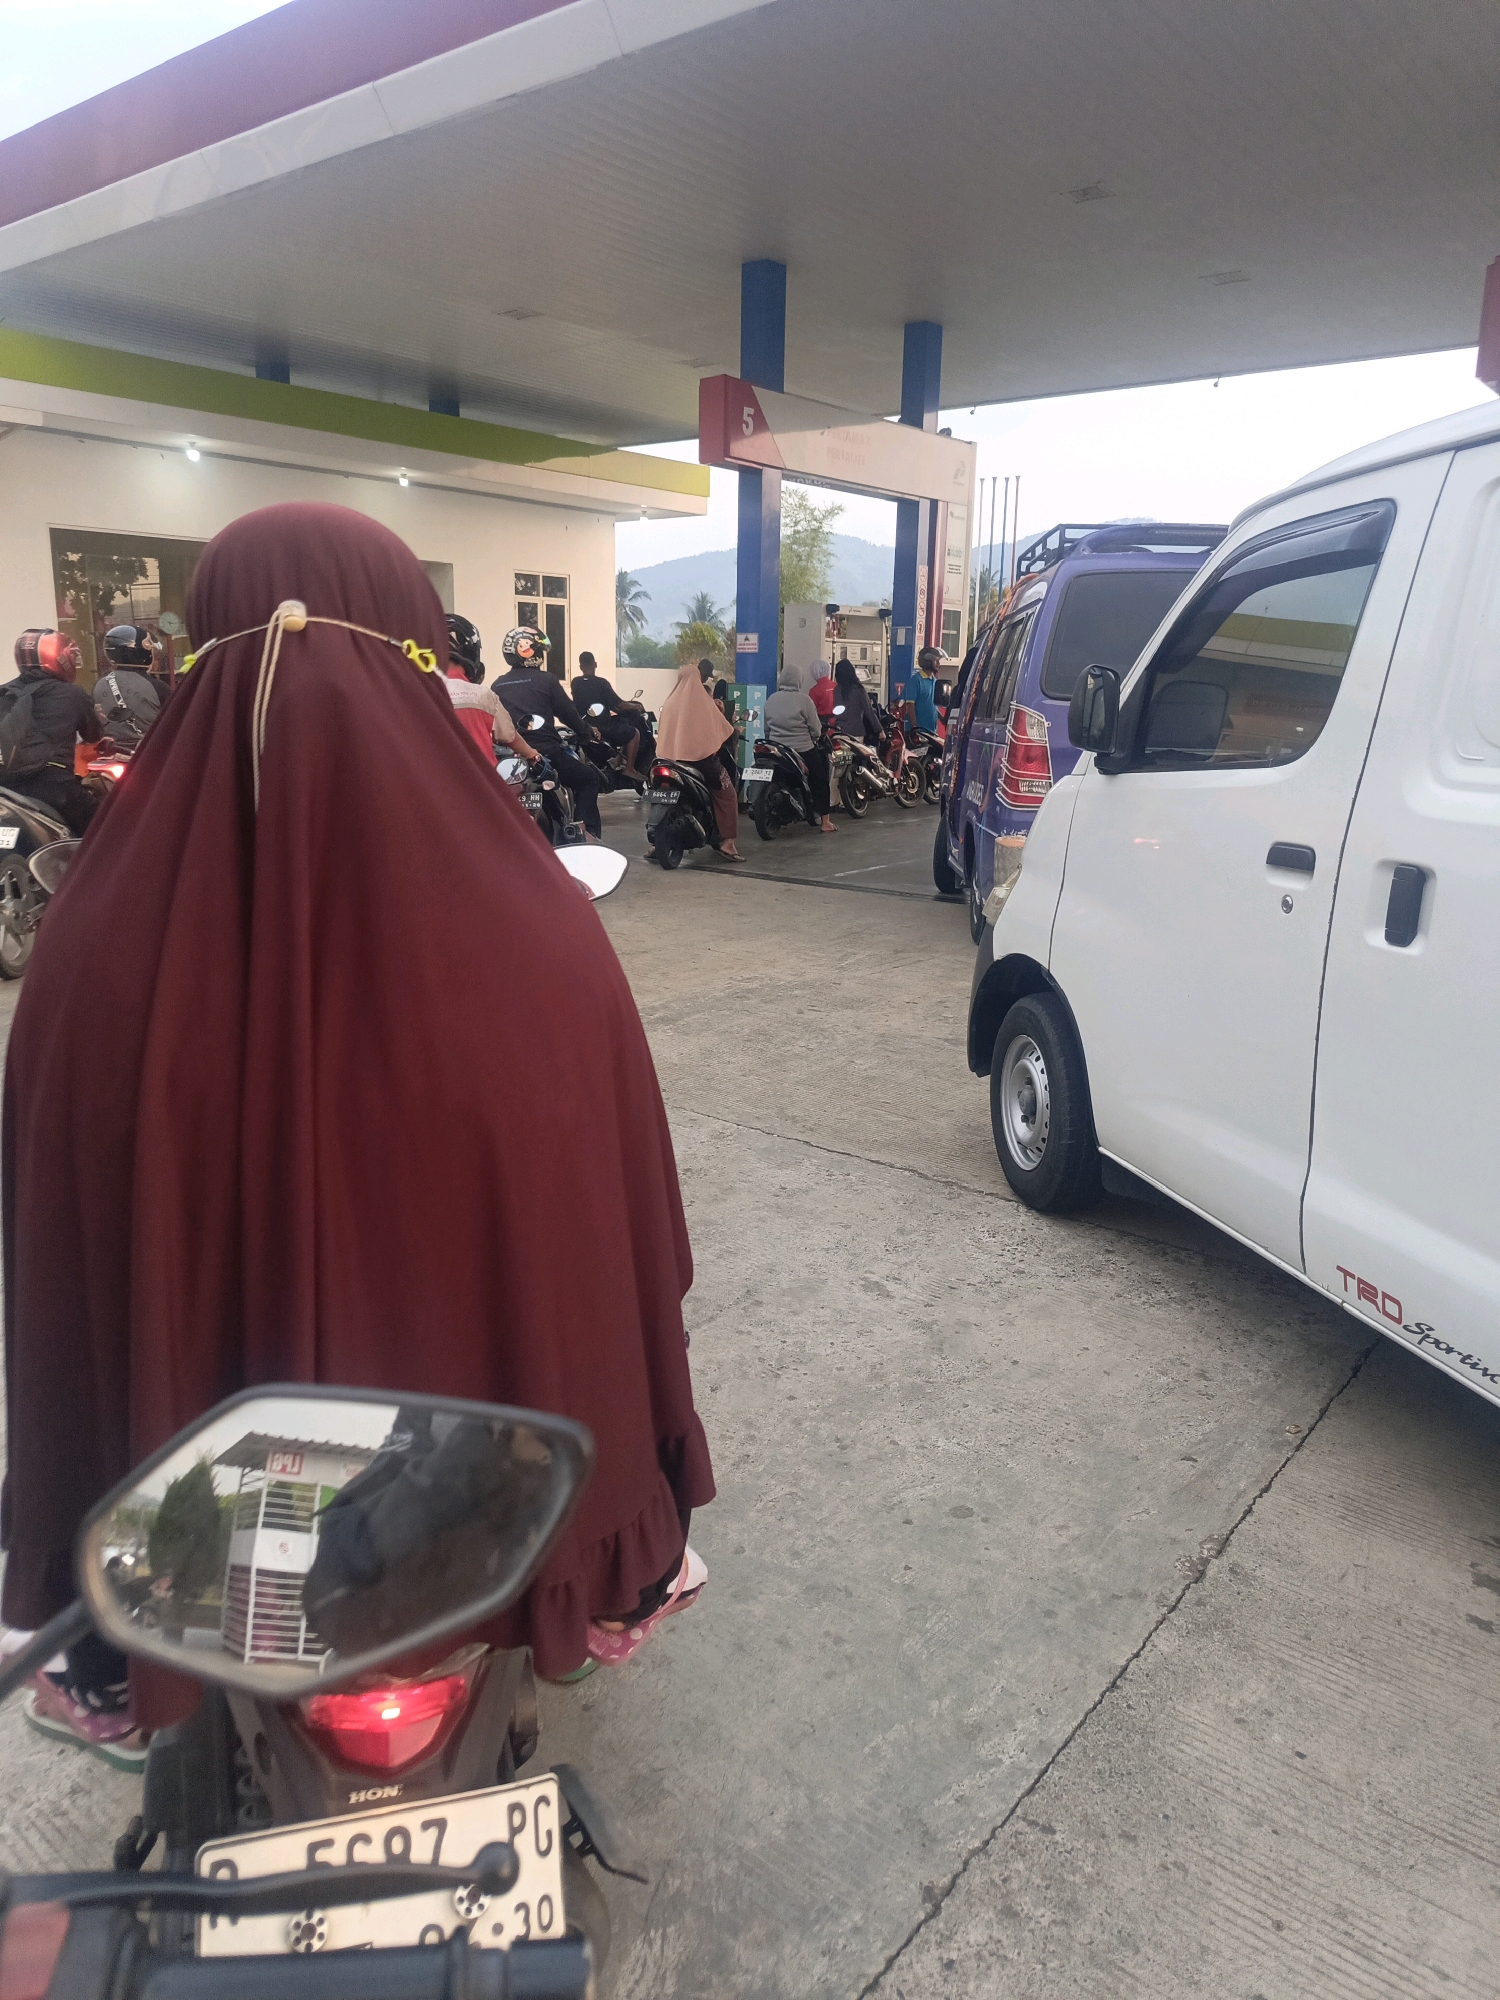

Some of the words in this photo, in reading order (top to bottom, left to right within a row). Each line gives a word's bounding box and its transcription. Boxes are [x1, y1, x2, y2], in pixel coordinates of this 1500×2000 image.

[742, 406, 755, 436] 5
[1336, 1264, 1403, 1326] TRD
[348, 1784, 404, 1804] HON
[507, 1795, 553, 1858] PC
